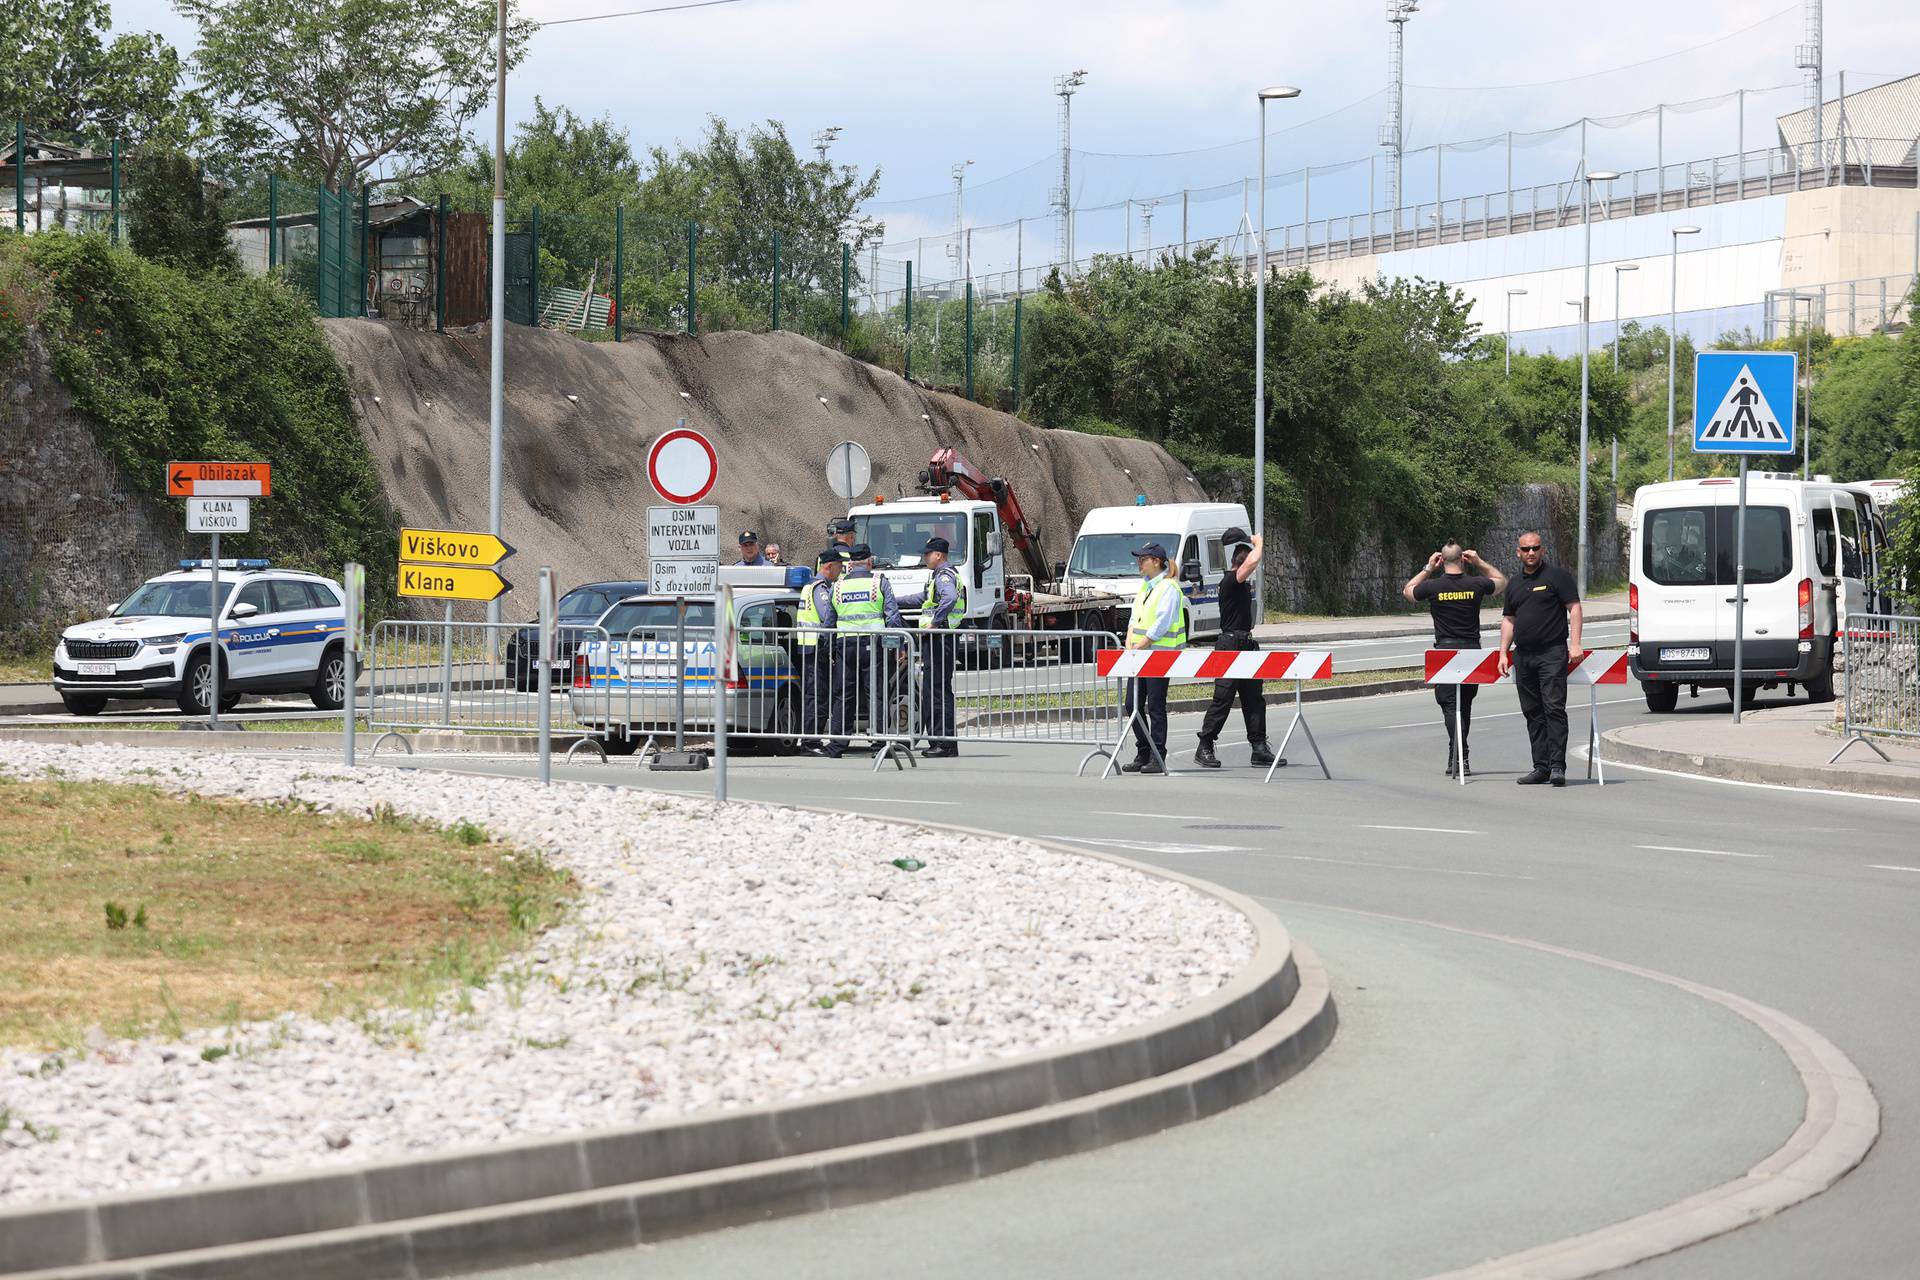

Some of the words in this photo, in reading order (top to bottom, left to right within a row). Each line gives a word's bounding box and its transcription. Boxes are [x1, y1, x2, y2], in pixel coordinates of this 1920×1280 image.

[200, 465, 257, 480] Obilazak
[203, 502, 233, 512] KLANA
[199, 514, 238, 527] VIŠKOVO
[672, 510, 696, 522] OSIM
[651, 524, 716, 537] INTERVENTNIH
[408, 536, 479, 558] Viškovo
[668, 539, 700, 551] VOZILA
[655, 563, 677, 575] Osim
[691, 563, 716, 575] vozila
[404, 571, 454, 591] Klana
[654, 580, 661, 592] S
[666, 580, 711, 592] dozvolom
[842, 593, 869, 601] POLICIJA
[1438, 591, 1475, 600] SECURITY
[240, 632, 271, 643] POLICIJA
